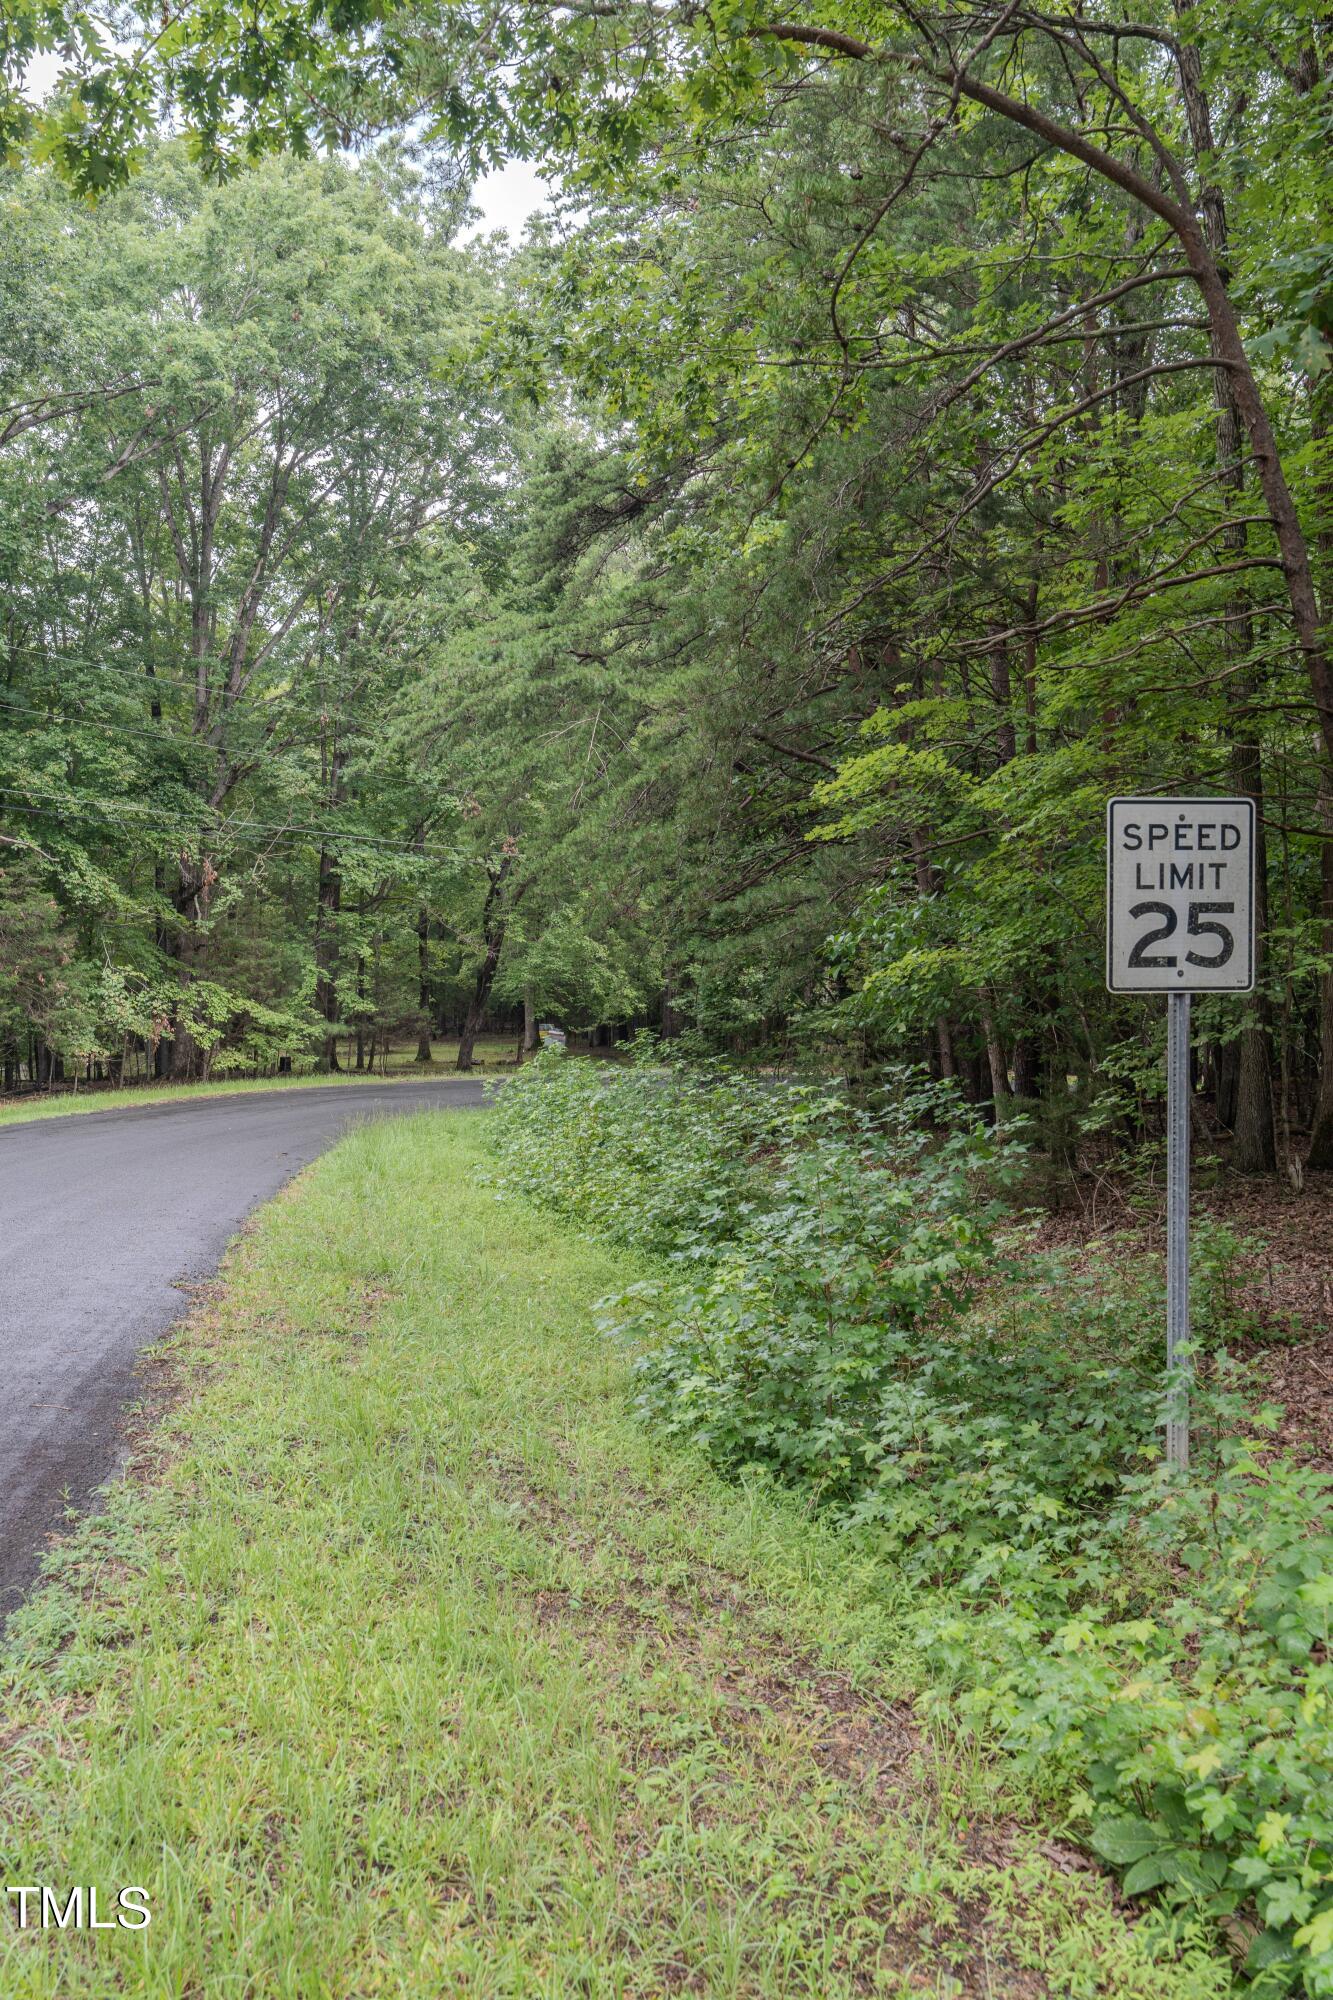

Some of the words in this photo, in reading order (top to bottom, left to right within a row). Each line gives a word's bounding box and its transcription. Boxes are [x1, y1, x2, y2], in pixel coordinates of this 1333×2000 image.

[1122, 823, 1241, 851] SPEED
[1135, 862, 1228, 890] LIMIT
[1127, 901, 1235, 968] 25
